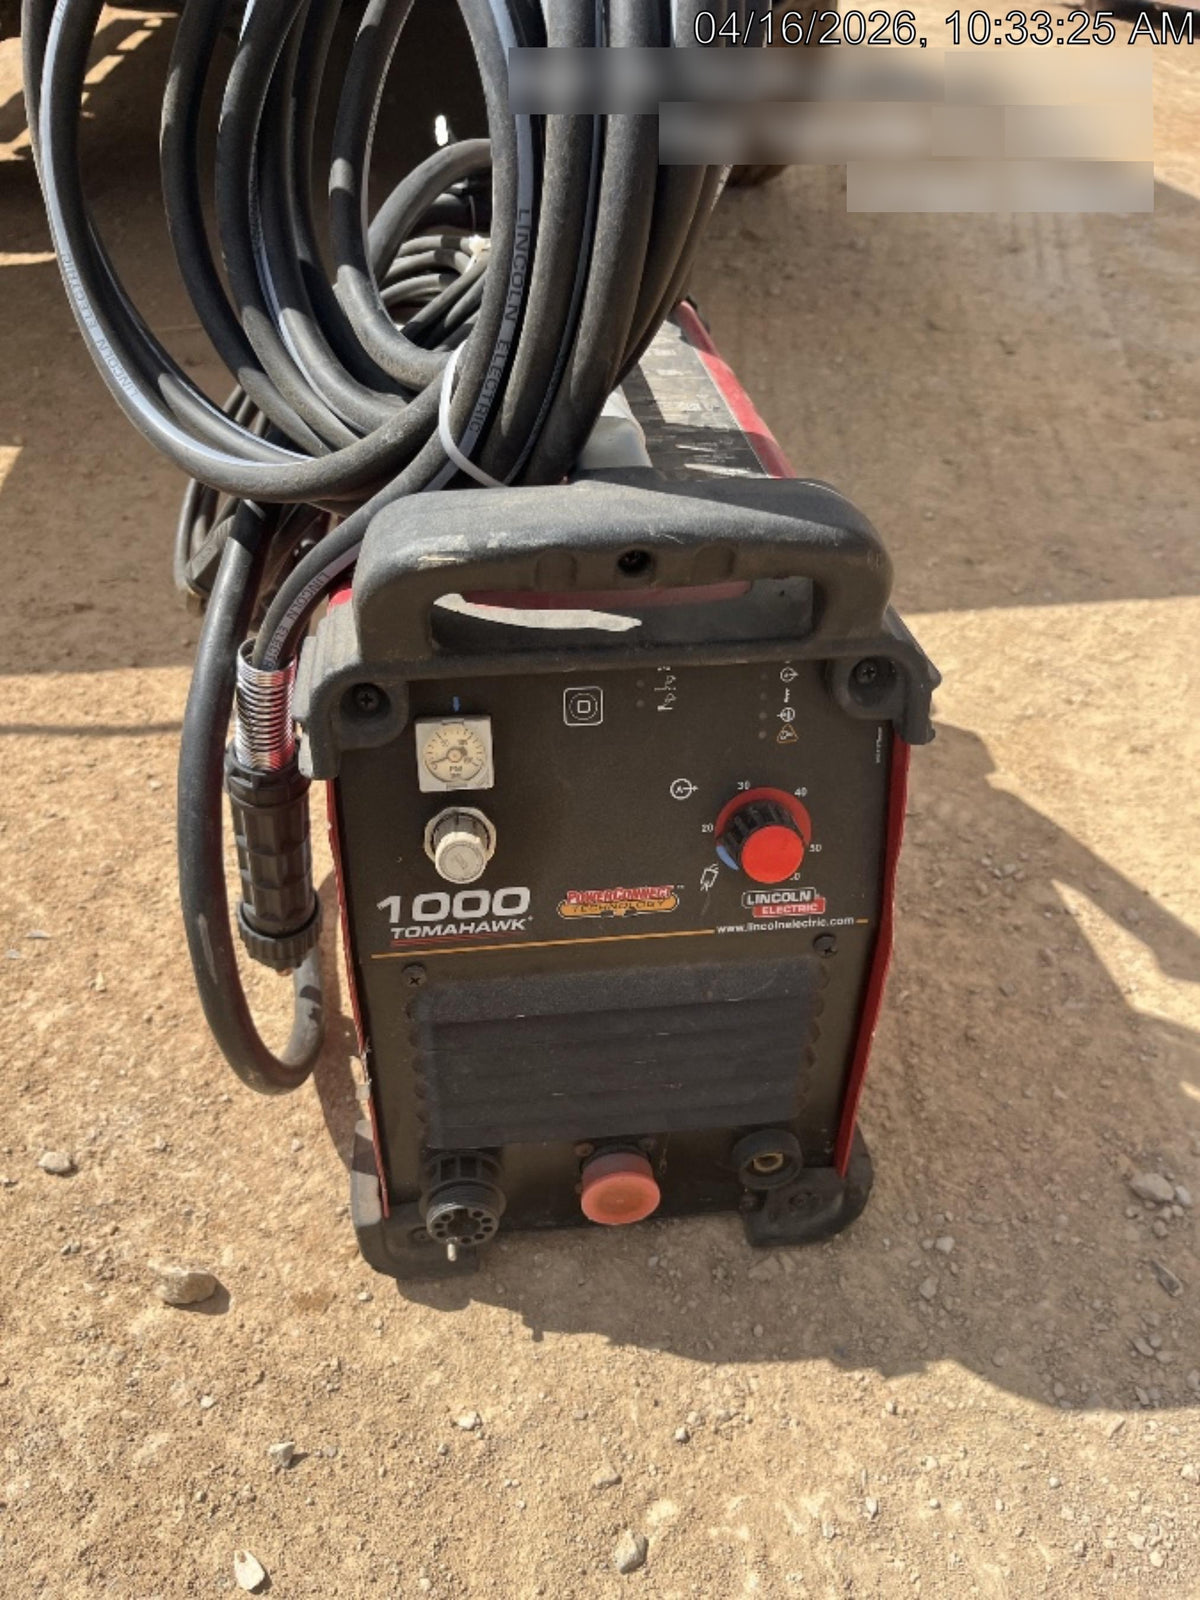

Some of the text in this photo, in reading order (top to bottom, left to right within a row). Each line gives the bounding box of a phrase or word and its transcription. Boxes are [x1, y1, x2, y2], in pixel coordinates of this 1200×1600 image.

[61, 253, 138, 397] LINCOLN ELECTRIC
[469, 208, 531, 434] LINCOLN ELECTRIC
[287, 572, 330, 620] LINCOLN
[737, 781, 751, 790] 30
[794, 787, 808, 798] 40
[701, 824, 714, 833] 20
[790, 873, 801, 881] 0
[376, 886, 531, 924] 1000
[746, 890, 812, 906] LINCOLN
[573, 899, 666, 914] TECHNOLOGY
[761, 904, 819, 915] ELECTRIC
[391, 918, 527, 940] TOMAHAWK
[716, 916, 855, 933] www.lincolnelectric.com
